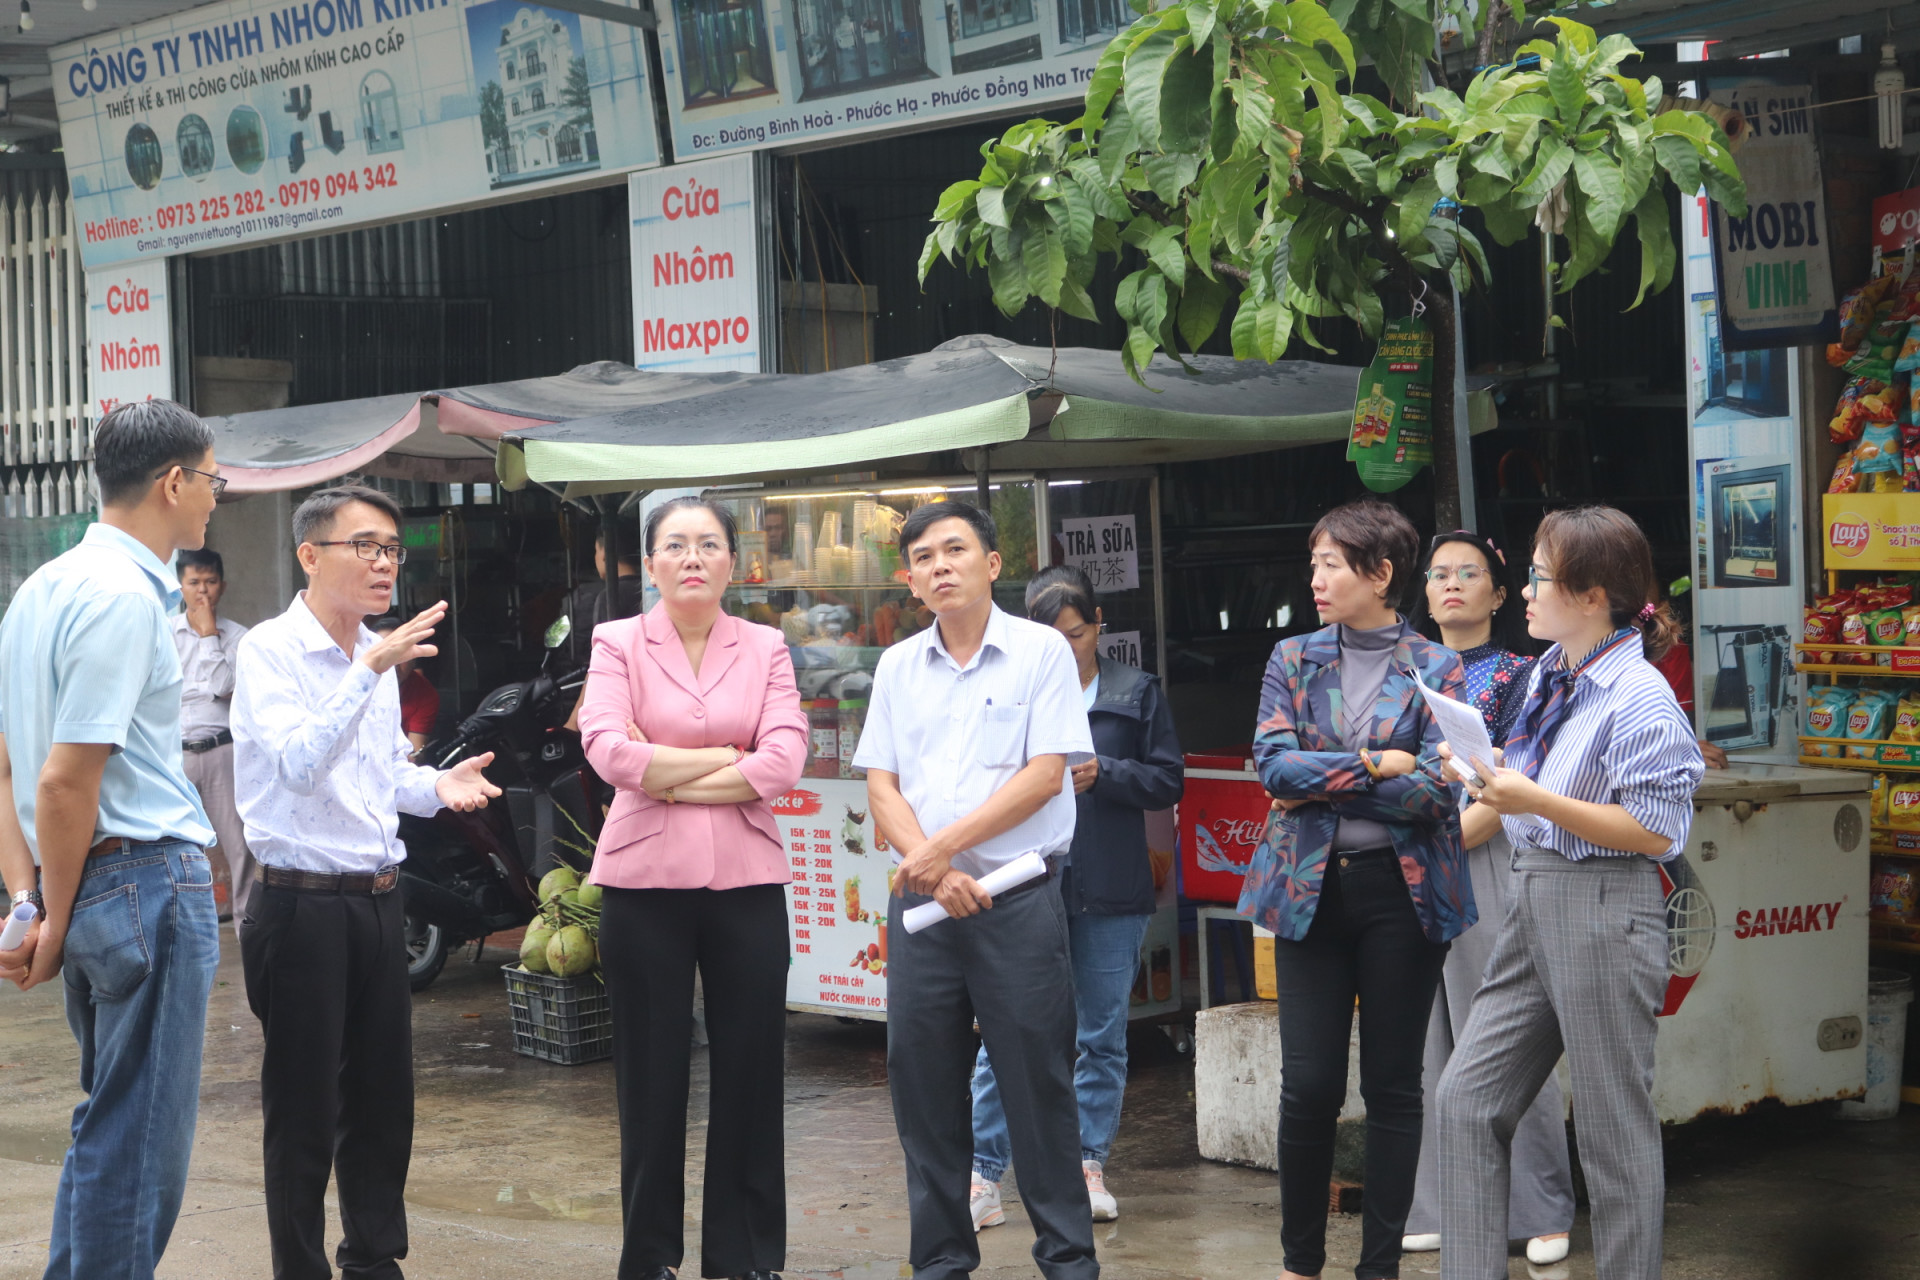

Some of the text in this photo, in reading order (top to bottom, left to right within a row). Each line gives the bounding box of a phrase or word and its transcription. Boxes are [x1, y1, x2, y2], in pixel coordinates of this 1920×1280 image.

[68, 48, 147, 98] CÔNG
[152, 36, 181, 77] TY
[188, 15, 264, 69] TNHH
[106, 26, 405, 119] THIẾT KẾ & THI CÔNG CỬA NHÔM KÍNH CAO CẤP
[693, 134, 716, 149] Đc:
[720, 125, 765, 144] Đường
[769, 117, 799, 136] Bình
[803, 110, 834, 130] Hoà
[846, 101, 892, 122] Phước
[896, 97, 918, 116] Hạ
[931, 87, 980, 108] Phước
[985, 76, 1029, 98] Đồng
[1033, 72, 1067, 90] Nha
[1767, 97, 1809, 137] SIM
[85, 216, 145, 244] Hotline:
[156, 202, 196, 231] 0973
[200, 196, 230, 222] 225
[234, 189, 265, 217] 282
[278, 178, 321, 208] 0979
[325, 170, 359, 198] 094
[363, 162, 398, 191] 342
[661, 178, 720, 222] Cửa
[1727, 200, 1820, 253] MOBI
[137, 238, 166, 252] Gmail:
[653, 246, 735, 288] Nhôm
[107, 278, 149, 315] Cửa
[1745, 260, 1808, 310] VINA
[643, 313, 750, 355] Maxpro
[101, 337, 161, 373] Nhôm
[1066, 522, 1134, 556] TRÀ SỮA
[1832, 523, 1868, 548] Lay's
[1882, 525, 1908, 534] Snack
[790, 828, 805, 838] 15K
[813, 829, 832, 839] 20K
[791, 842, 806, 852] 15K
[814, 843, 832, 854] 20K
[792, 856, 806, 867] 15K
[814, 858, 833, 868] 20K
[792, 871, 807, 881] 15K
[815, 873, 833, 883] 20K
[793, 885, 811, 896] 20K
[818, 888, 837, 898] 25K
[794, 900, 809, 910] 15K
[817, 902, 835, 912] 20K
[795, 914, 810, 925] 15K
[818, 916, 836, 927] 20K
[795, 929, 811, 939] 10K
[1734, 902, 1842, 940] SANAKY
[796, 943, 811, 954] 10K
[819, 990, 840, 1003] NƯỚC
[842, 994, 866, 1006] CHANH
[867, 996, 881, 1007] LEO
